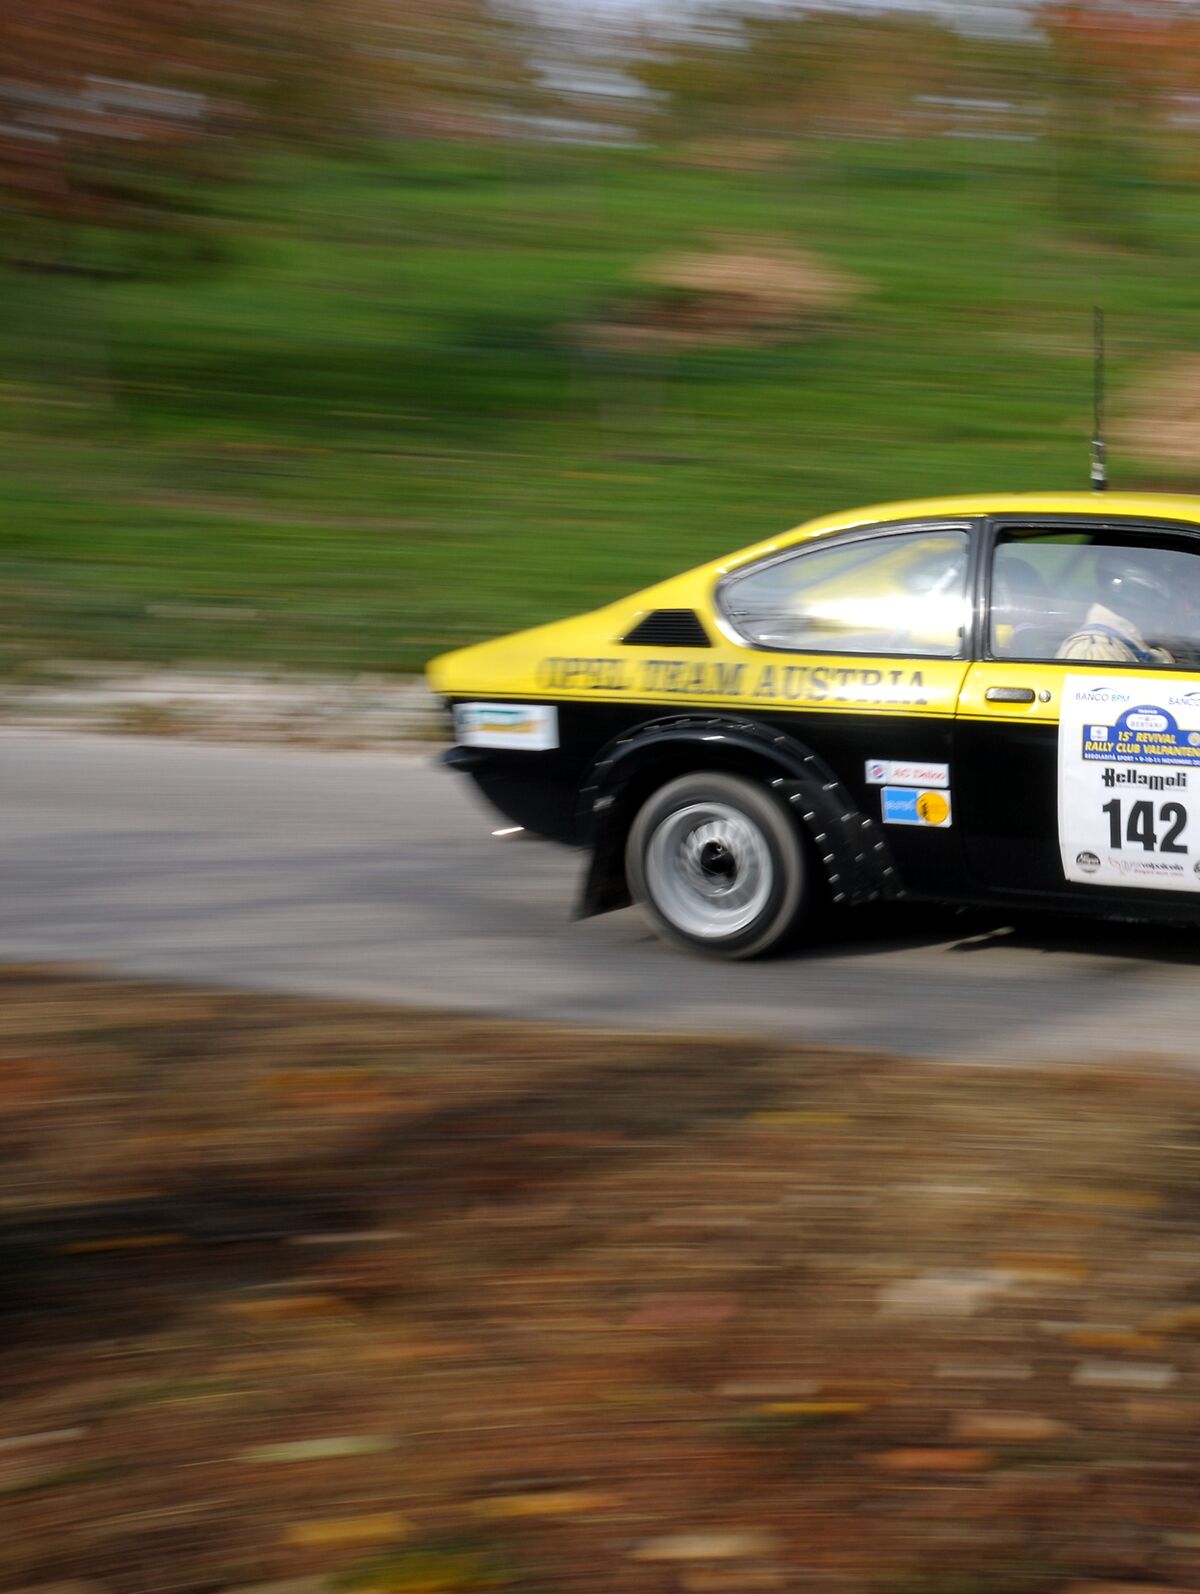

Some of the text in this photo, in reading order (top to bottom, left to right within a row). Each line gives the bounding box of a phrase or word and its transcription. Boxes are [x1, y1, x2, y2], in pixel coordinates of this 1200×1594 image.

[536, 656, 929, 705] OPEL TEAM AUSTRIA
[1075, 692, 1109, 702] BANCO
[1136, 732, 1176, 744] REVIVAL
[1085, 741, 1114, 752] RALLY
[1116, 743, 1141, 754] CLUB
[1101, 767, 1187, 791] Bellamoli
[1102, 798, 1189, 854] 142
